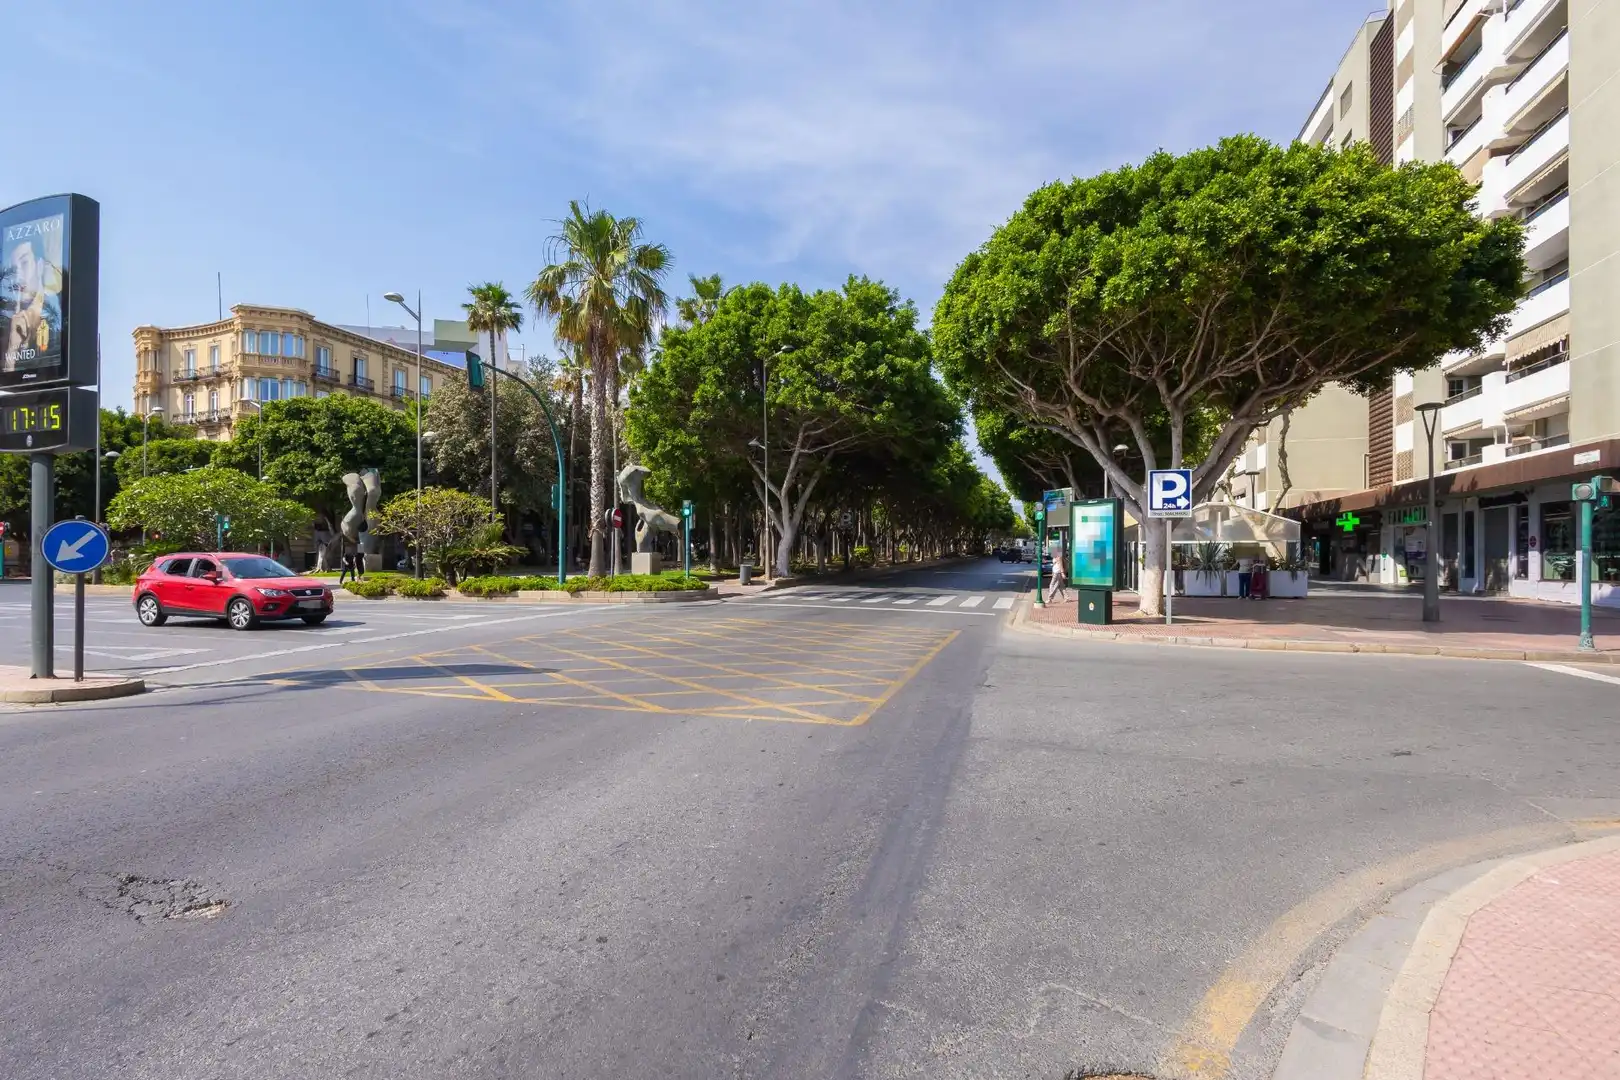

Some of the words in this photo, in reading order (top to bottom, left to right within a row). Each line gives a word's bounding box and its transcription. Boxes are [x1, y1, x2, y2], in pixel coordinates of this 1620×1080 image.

[6, 218, 60, 241] AZZARO
[5, 348, 36, 362] WANTED
[13, 404, 61, 431] 17:15
[1152, 472, 1187, 509] P
[1388, 506, 1427, 524] FARMACIA
